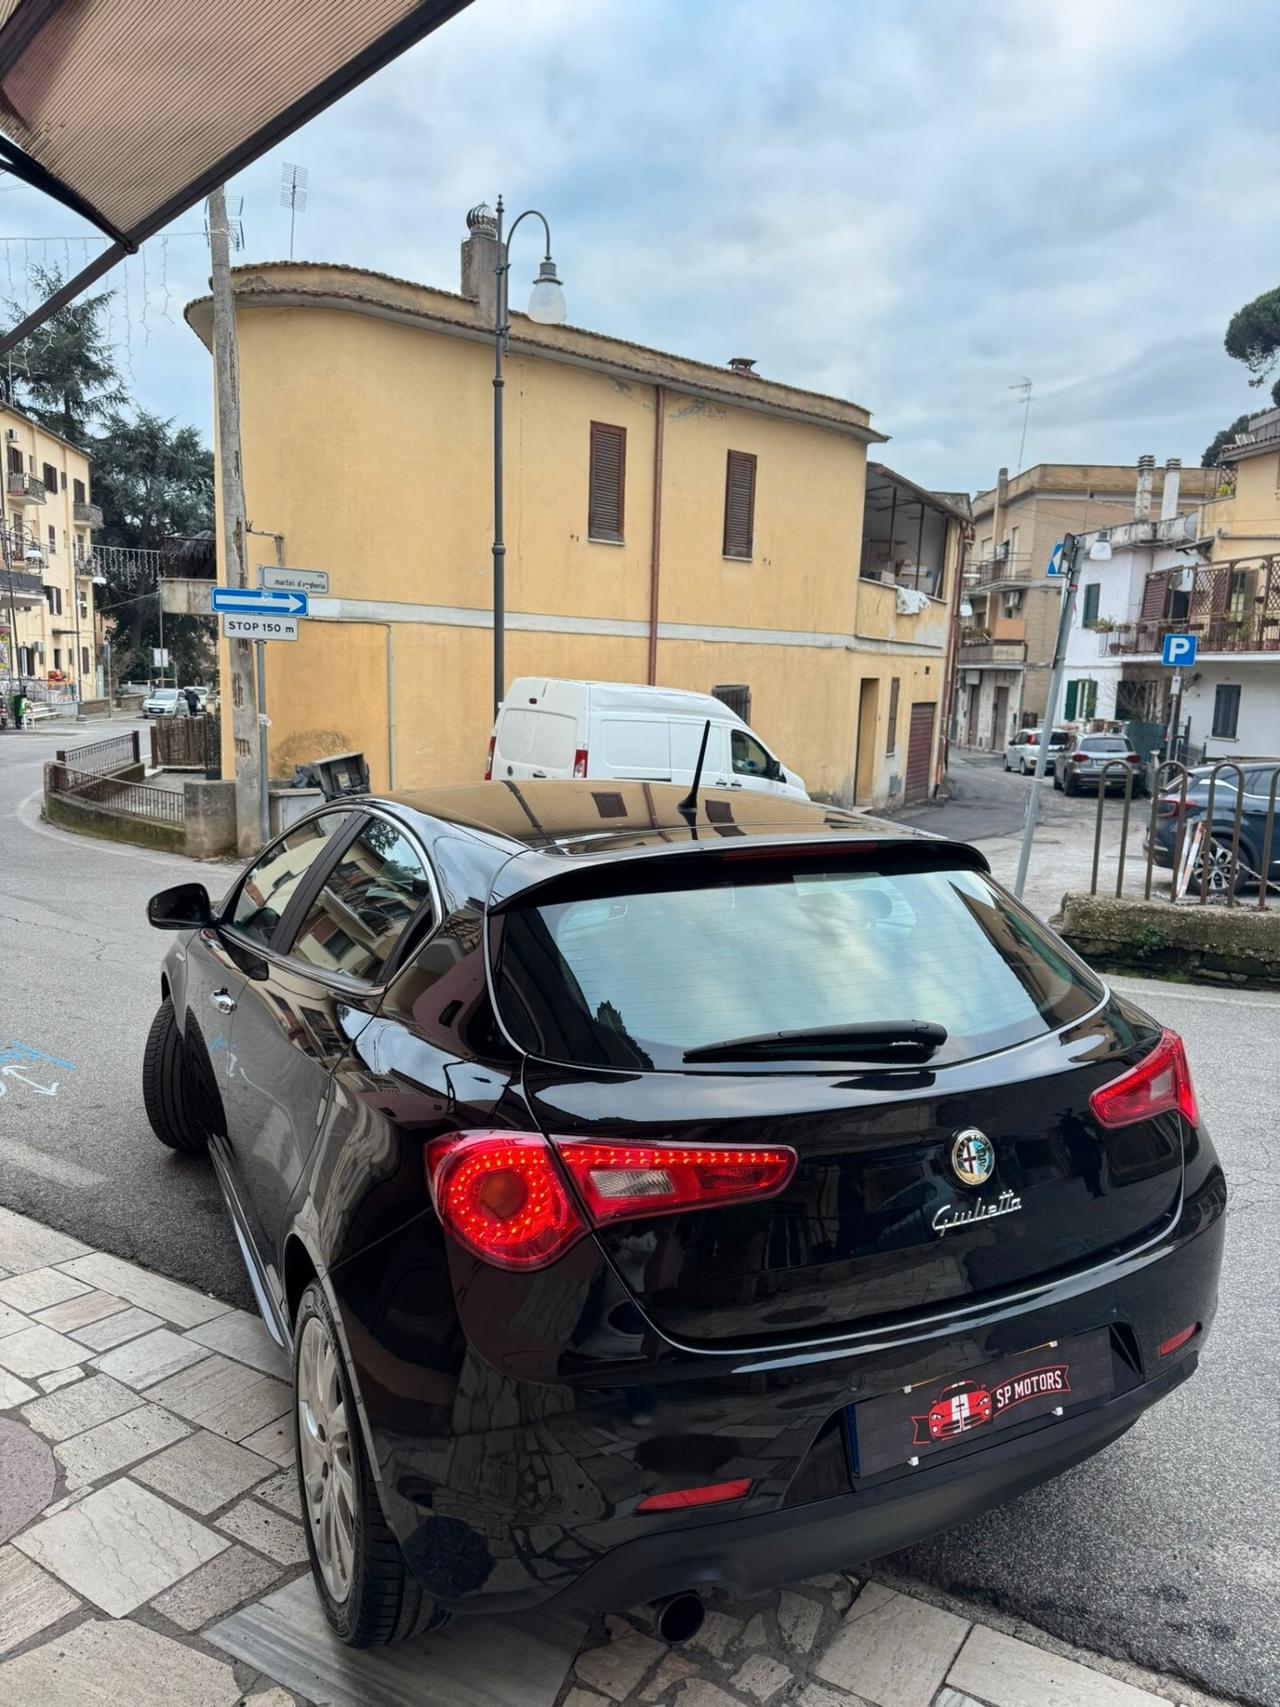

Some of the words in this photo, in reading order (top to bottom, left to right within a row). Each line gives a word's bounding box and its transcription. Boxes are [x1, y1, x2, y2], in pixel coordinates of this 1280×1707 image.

[228, 621, 259, 632] STOP
[263, 623, 281, 633] 150
[285, 626, 295, 634] m
[1168, 637, 1190, 662] P
[932, 1189, 1022, 1237] Giulietta
[996, 1387, 1013, 1408] SP
[1014, 1370, 1063, 1401] MOTORS
